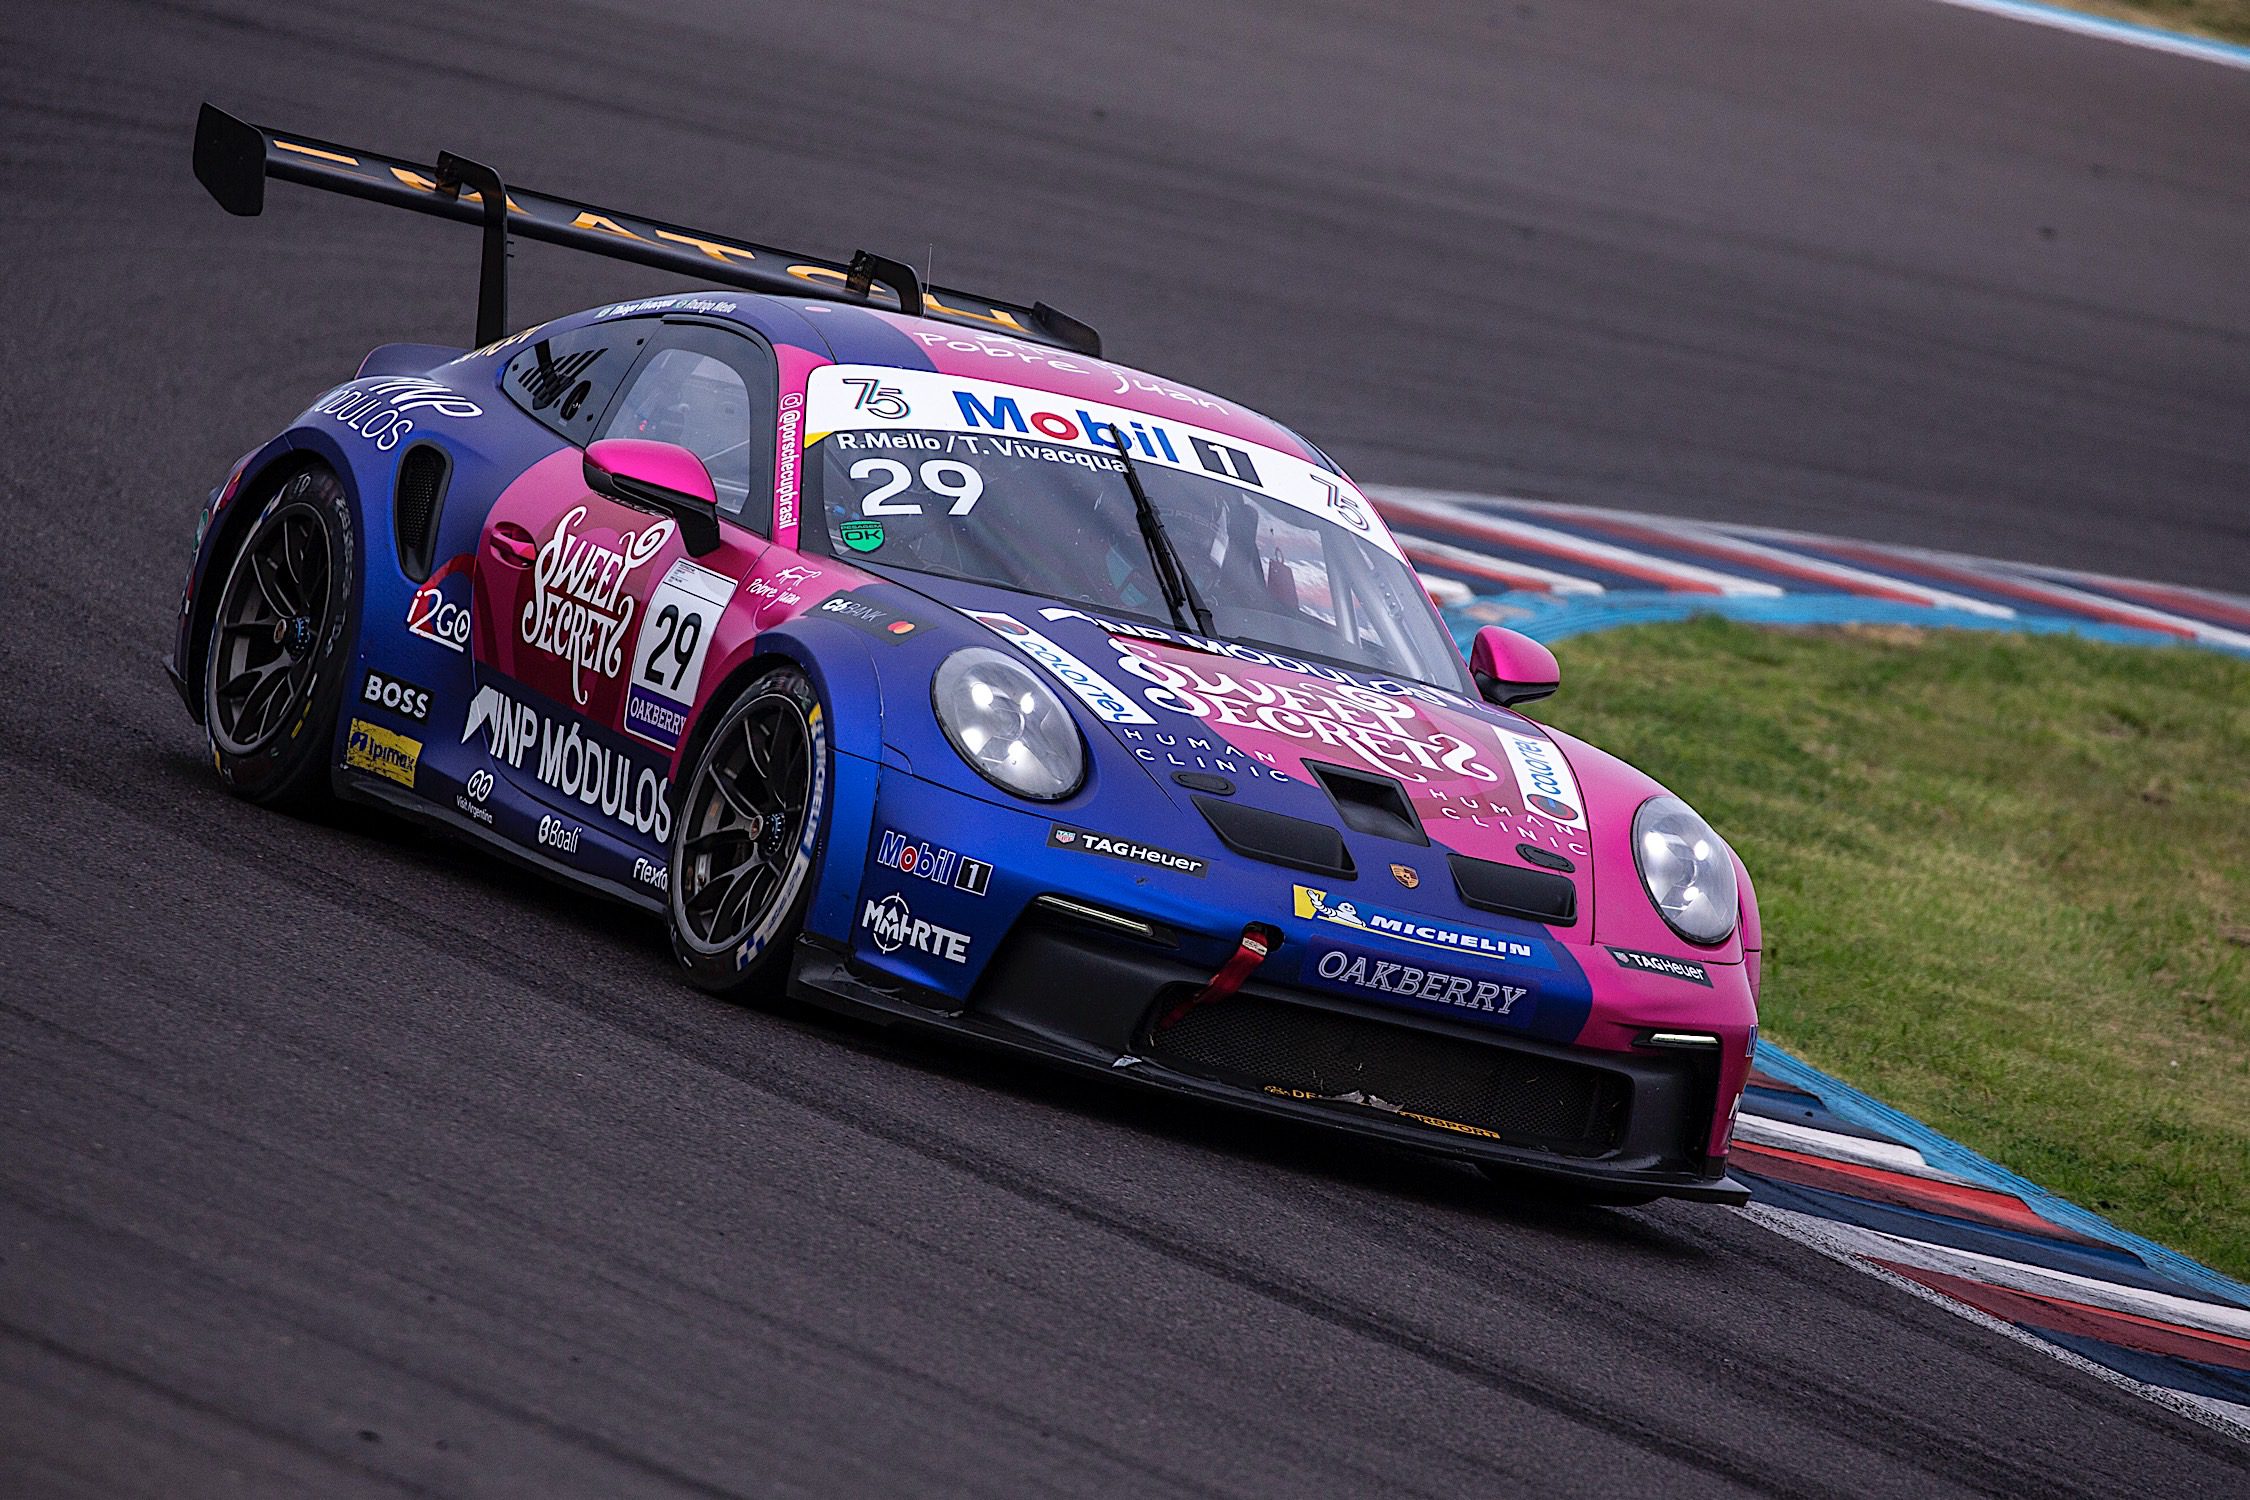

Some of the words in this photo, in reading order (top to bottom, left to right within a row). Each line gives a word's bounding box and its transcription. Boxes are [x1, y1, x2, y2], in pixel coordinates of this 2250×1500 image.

[913, 332, 1090, 374] Pobre
[778, 410, 801, 530] @porschecupbrasil
[842, 378, 911, 419] 75
[952, 390, 1180, 464] Mobil
[1310, 473, 1369, 531] 75
[850, 457, 985, 517] 29
[844, 529, 882, 541] OK
[746, 578, 778, 598] Pobre
[644, 603, 702, 692] 29
[364, 674, 429, 719] BOSS
[630, 696, 687, 737] OAKBERRY
[537, 718, 671, 843] MÓDULOS
[1136, 748, 1289, 783] CLINIC
[549, 819, 583, 853] Boali
[1441, 807, 1588, 855] CLINIC
[877, 830, 956, 885] Mobil
[1370, 915, 1531, 957] MICHELIN
[1318, 951, 1527, 1014] OAKBERRY
